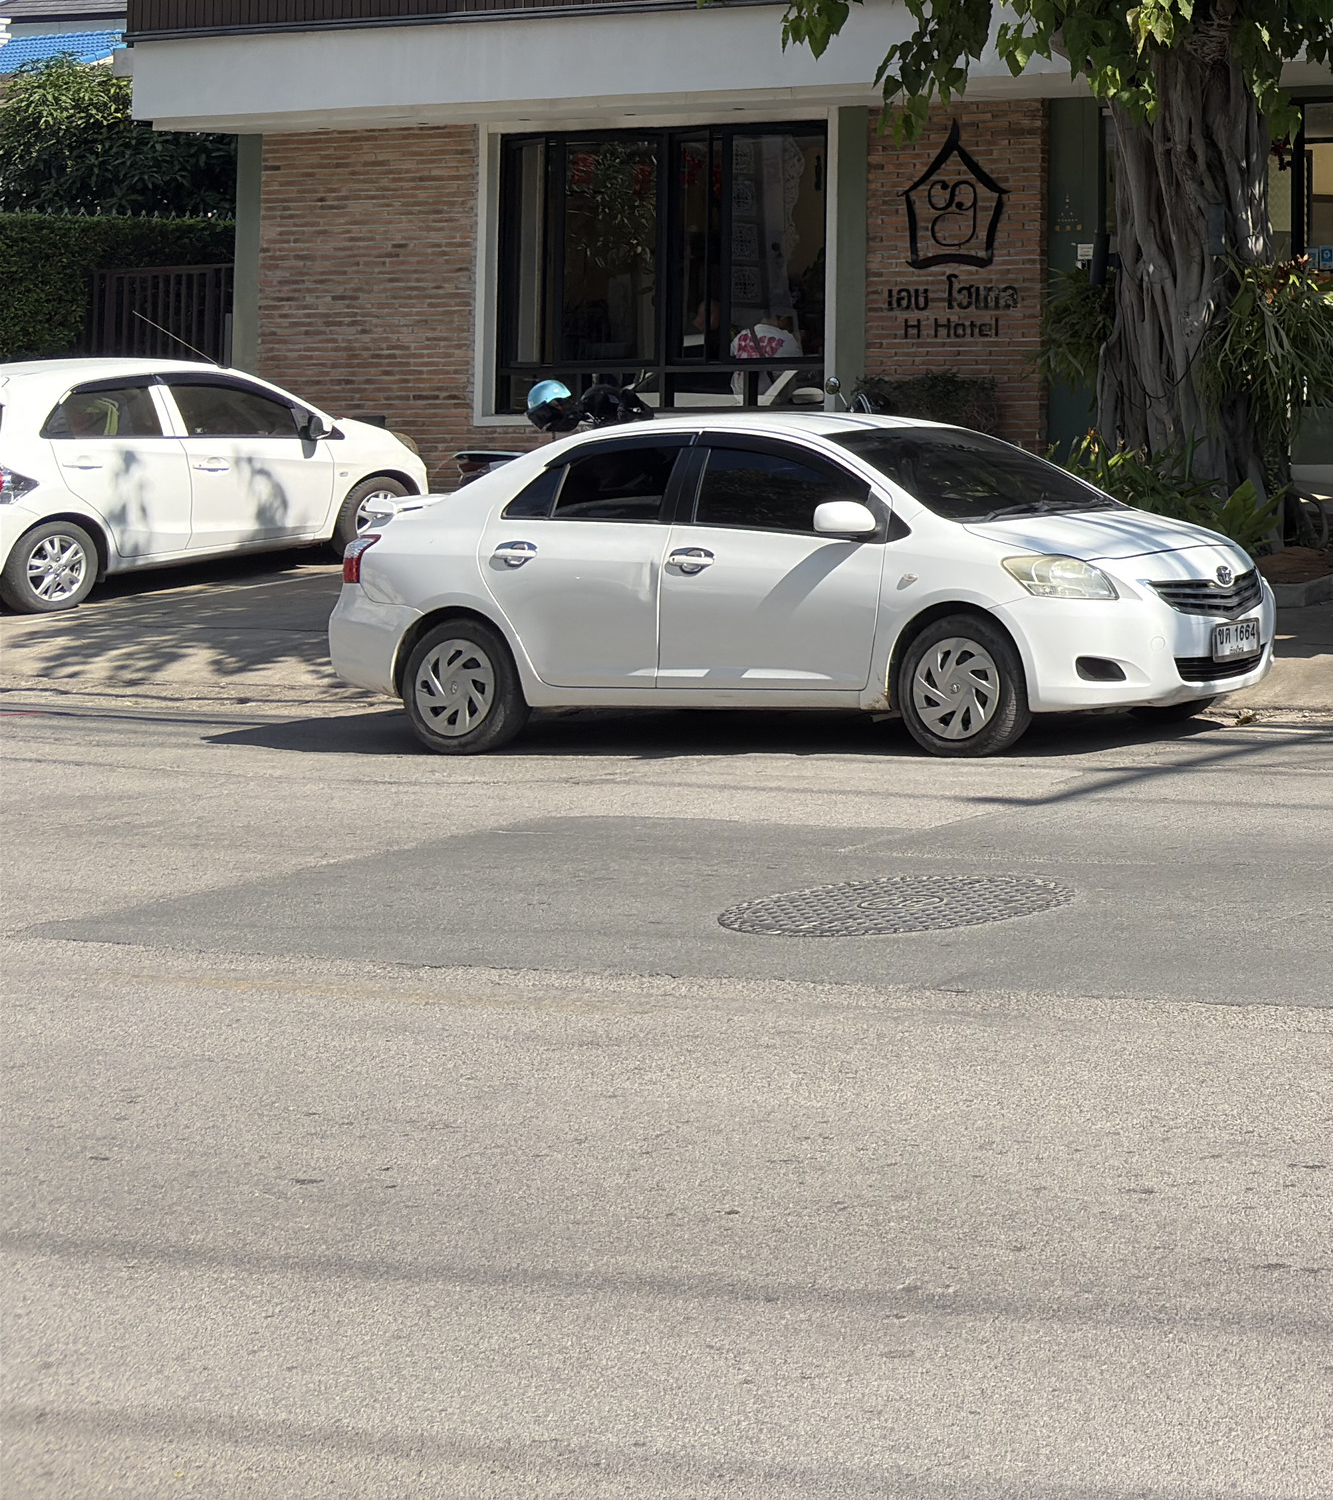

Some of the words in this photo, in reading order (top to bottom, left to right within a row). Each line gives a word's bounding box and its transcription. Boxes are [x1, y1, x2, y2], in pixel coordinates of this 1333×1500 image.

[887, 287, 929, 311] เอช
[946, 273, 1019, 311] โฮเทล
[904, 318, 921, 339] H
[934, 318, 999, 339] Hotel
[1235, 623, 1256, 642] 1664
